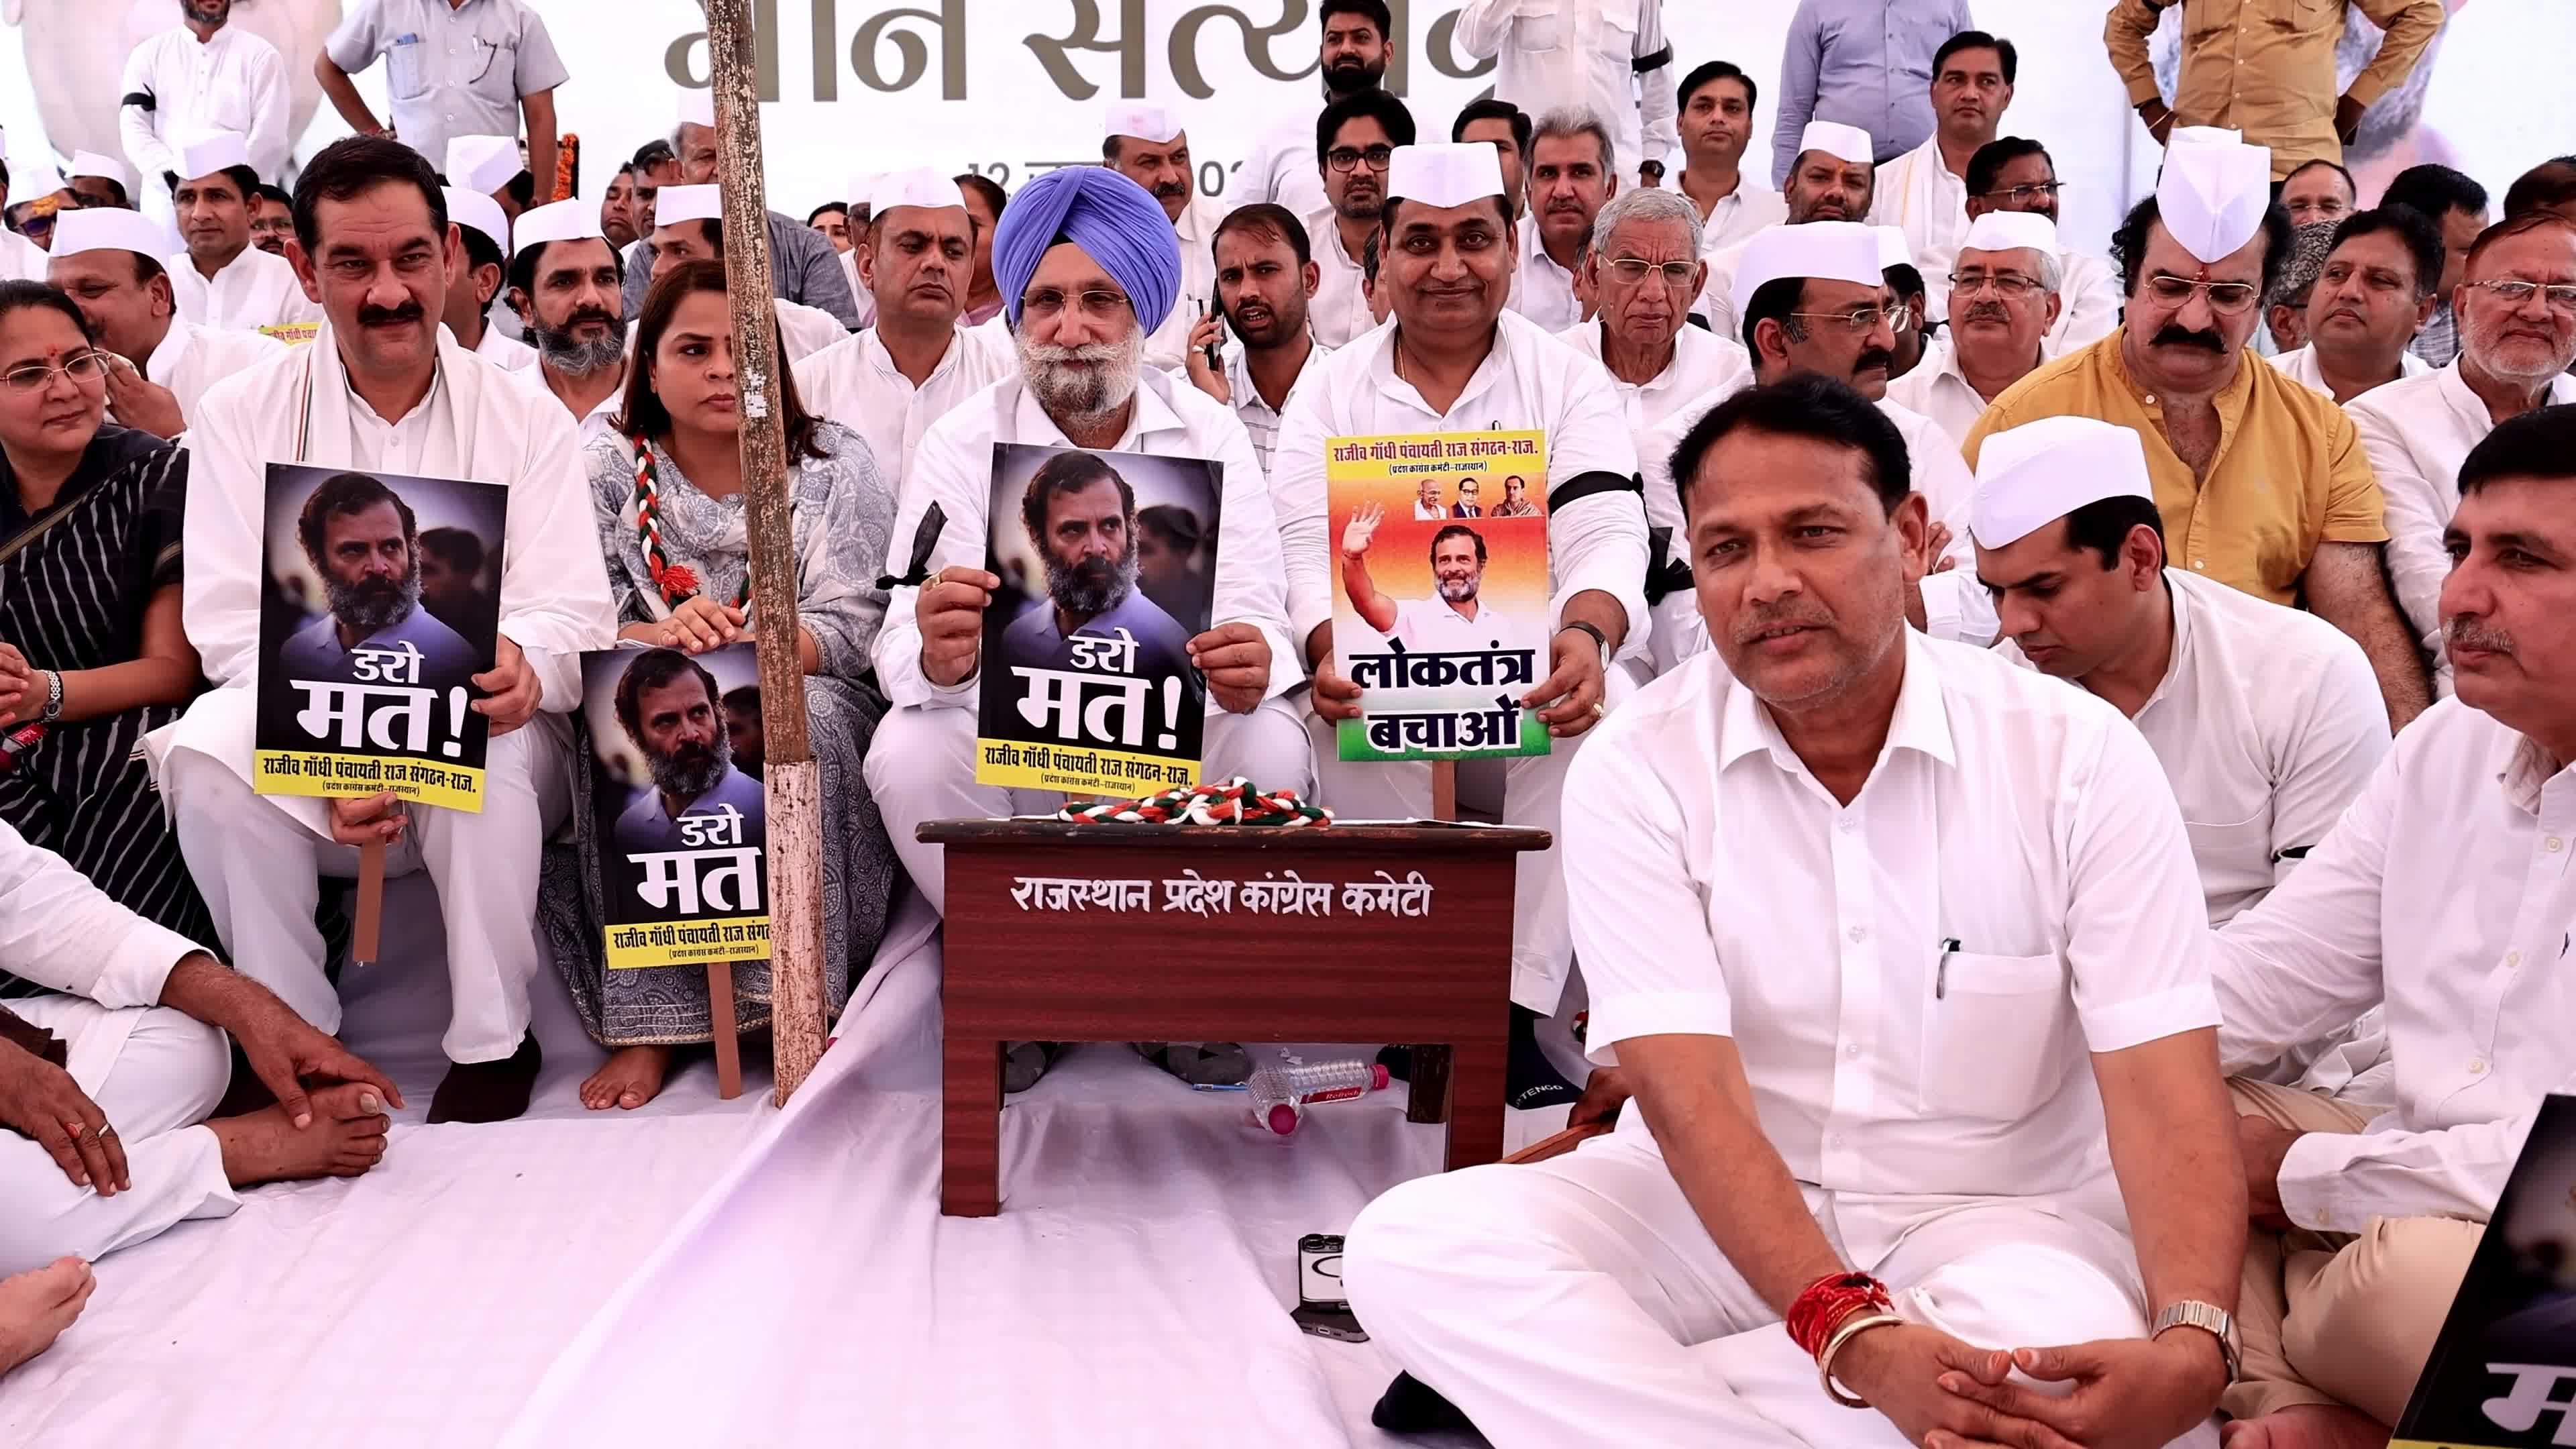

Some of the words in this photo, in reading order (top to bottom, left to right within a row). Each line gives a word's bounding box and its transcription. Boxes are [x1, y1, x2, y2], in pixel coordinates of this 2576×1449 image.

[1334, 443, 1367, 462] राजीव
[1400, 440, 1442, 459] पंचायती
[1446, 443, 1467, 457] राज
[351, 641, 425, 684] डरो
[1068, 627, 1140, 674] डरो
[1348, 636, 1536, 689] लोकतंत्र
[263, 754, 300, 775] राजीव
[335, 757, 381, 780] पंचायती
[384, 765, 407, 781] राज
[985, 743, 1020, 766] राजीव
[1053, 748, 1097, 774] पंचायती
[1100, 758, 1122, 776] राज
[676, 803, 745, 847] डरो
[626, 847, 762, 914] मत
[1010, 876, 1152, 913] राजस्थान
[1162, 868, 1236, 918] प्रदेश
[1240, 869, 1335, 918] कांग्रेस
[1342, 870, 1434, 918] कमेटी
[613, 927, 647, 949] राजीव
[678, 922, 721, 945] पंचायती
[722, 925, 745, 943] राज
